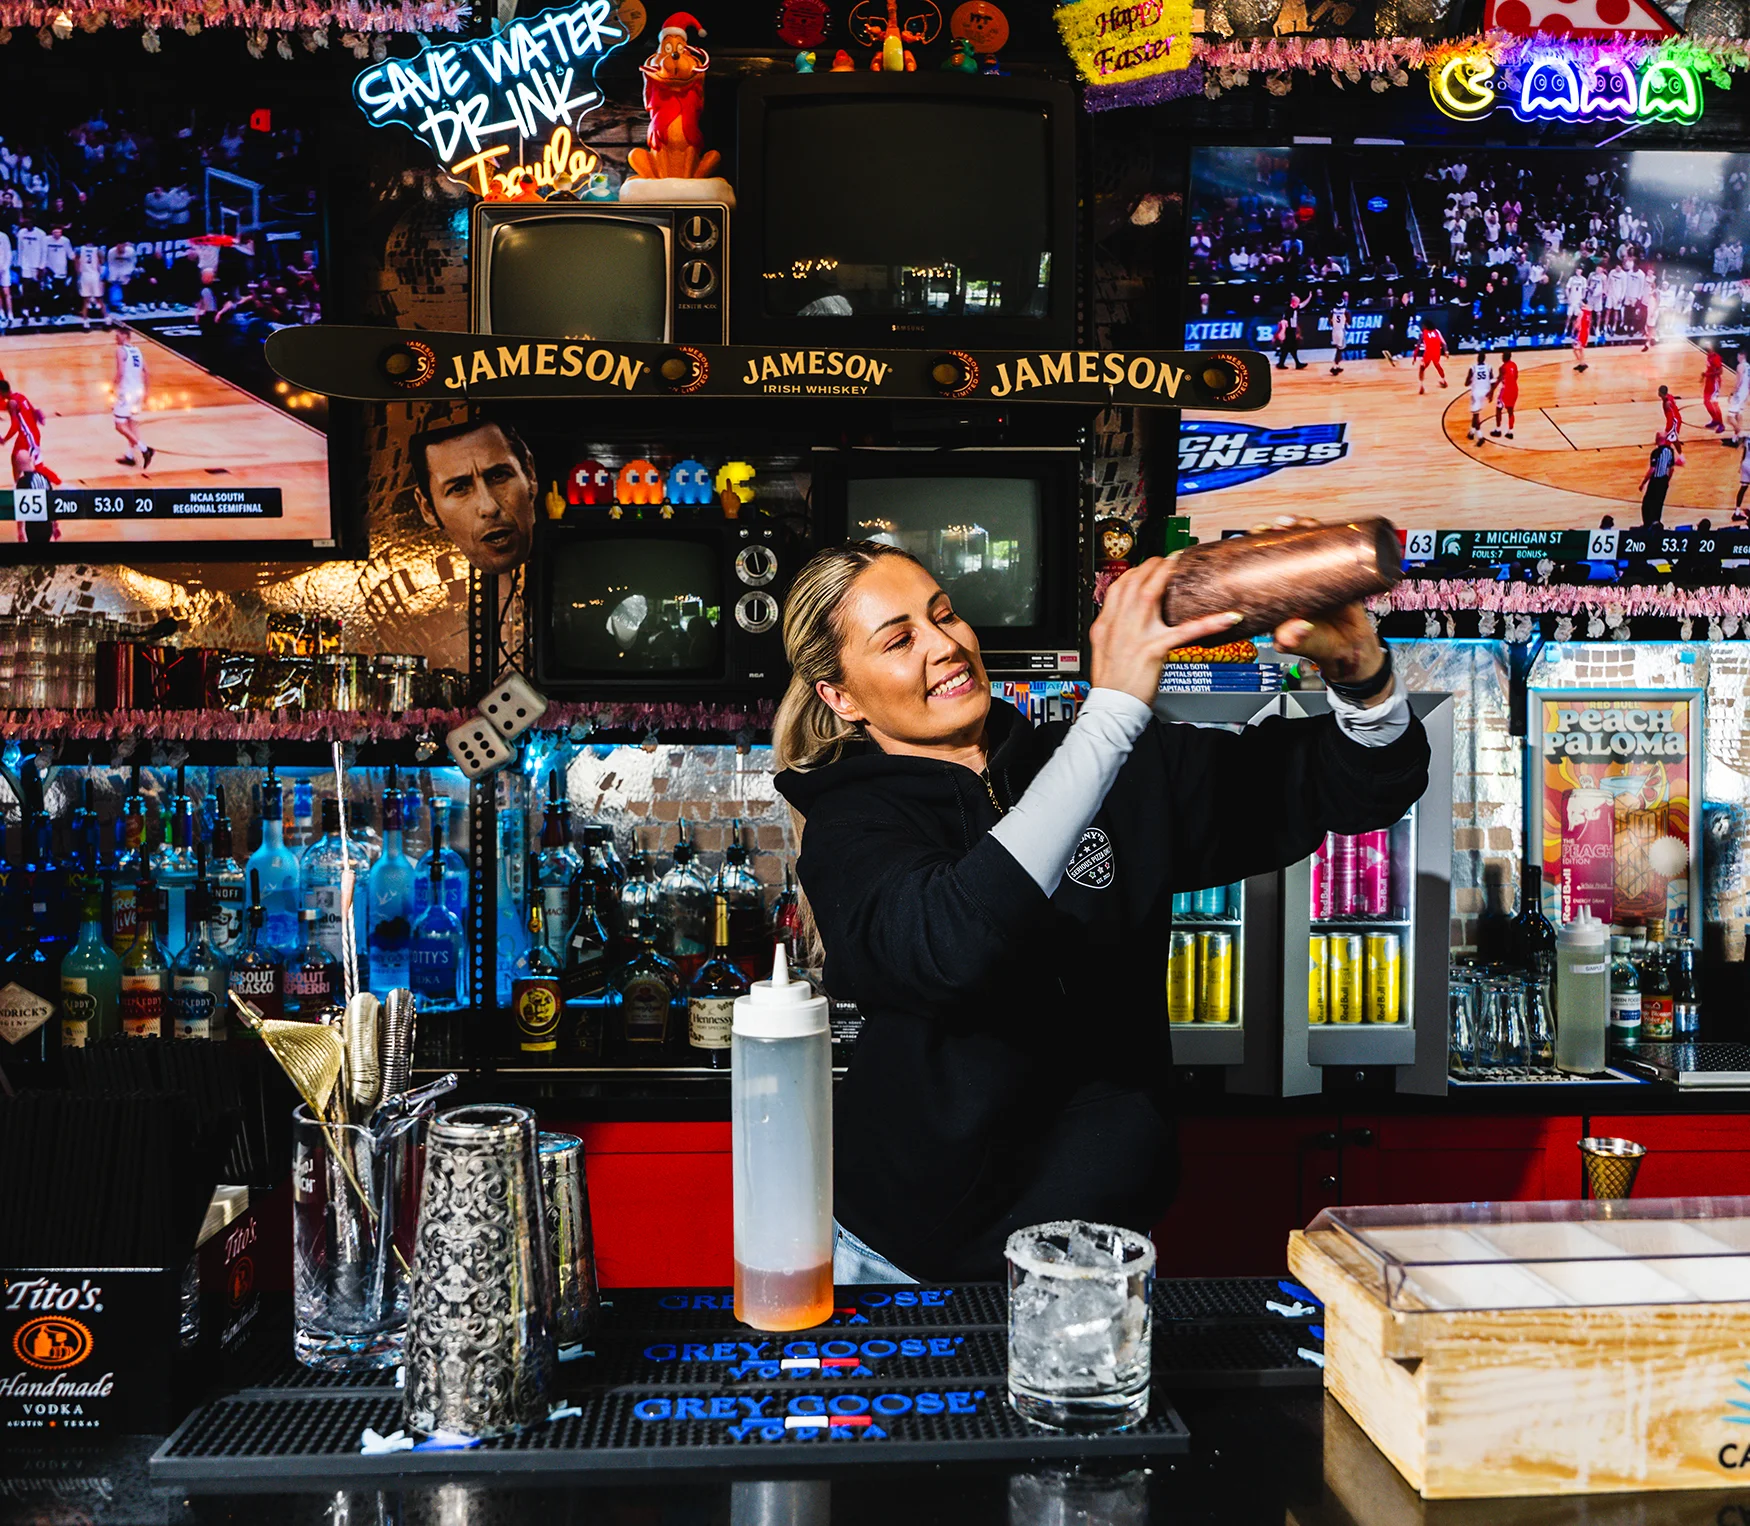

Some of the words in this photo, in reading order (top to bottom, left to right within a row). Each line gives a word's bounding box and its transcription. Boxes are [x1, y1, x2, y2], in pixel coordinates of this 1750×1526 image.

[1095, 0, 1163, 37] Happy
[358, 48, 470, 119] SAVE
[471, 0, 623, 84] WATER
[1094, 34, 1176, 76] Easter
[417, 67, 598, 163] DRINK
[891, 324, 925, 332] SAMSUNG
[444, 343, 645, 391] JAMESON
[743, 351, 888, 386] JAMESON
[989, 351, 1185, 398] JAMESON
[763, 384, 802, 394] IRISH
[805, 384, 868, 395] WHISKEY
[19, 495, 42, 514] 65
[54, 498, 78, 513] 2ND
[94, 497, 124, 512] 53.0
[135, 499, 153, 512] 20
[190, 493, 213, 502] NCAA
[215, 493, 244, 502] SOUTH
[173, 503, 216, 514] REGIONAL
[217, 503, 263, 514] SEMIFINAL
[1410, 535, 1432, 554] 63
[1475, 533, 1481, 543] 2
[1486, 532, 1547, 544] MICHIGAN
[1550, 532, 1563, 544] ST
[1592, 535, 1615, 554] 65
[1625, 538, 1646, 552] 2ND
[1699, 540, 1715, 552] 20
[1472, 550, 1497, 558] FOULS:
[1498, 550, 1503, 558] 7
[1562, 844, 1613, 858] PEACH
[1071, 859, 1093, 878] SERIOUS
[1563, 868, 1571, 894] Bull
[215, 889, 239, 898] NOFF
[1563, 895, 1571, 922] Red
[692, 1012, 732, 1025] Hennessy
[5, 1277, 102, 1312] Tito's
[658, 1295, 735, 1310] GRE
[643, 1341, 770, 1361] GREY
[783, 1338, 956, 1359] GOOSE
[0, 1372, 114, 1398] Handmade
[23, 1403, 84, 1415] VODKA
[633, 1396, 773, 1421] GREY
[787, 1391, 977, 1416] GOOSE
[7, 1420, 43, 1428] AUSTIN
[64, 1420, 100, 1428] TEXAS
[728, 1424, 887, 1442] VODKA
